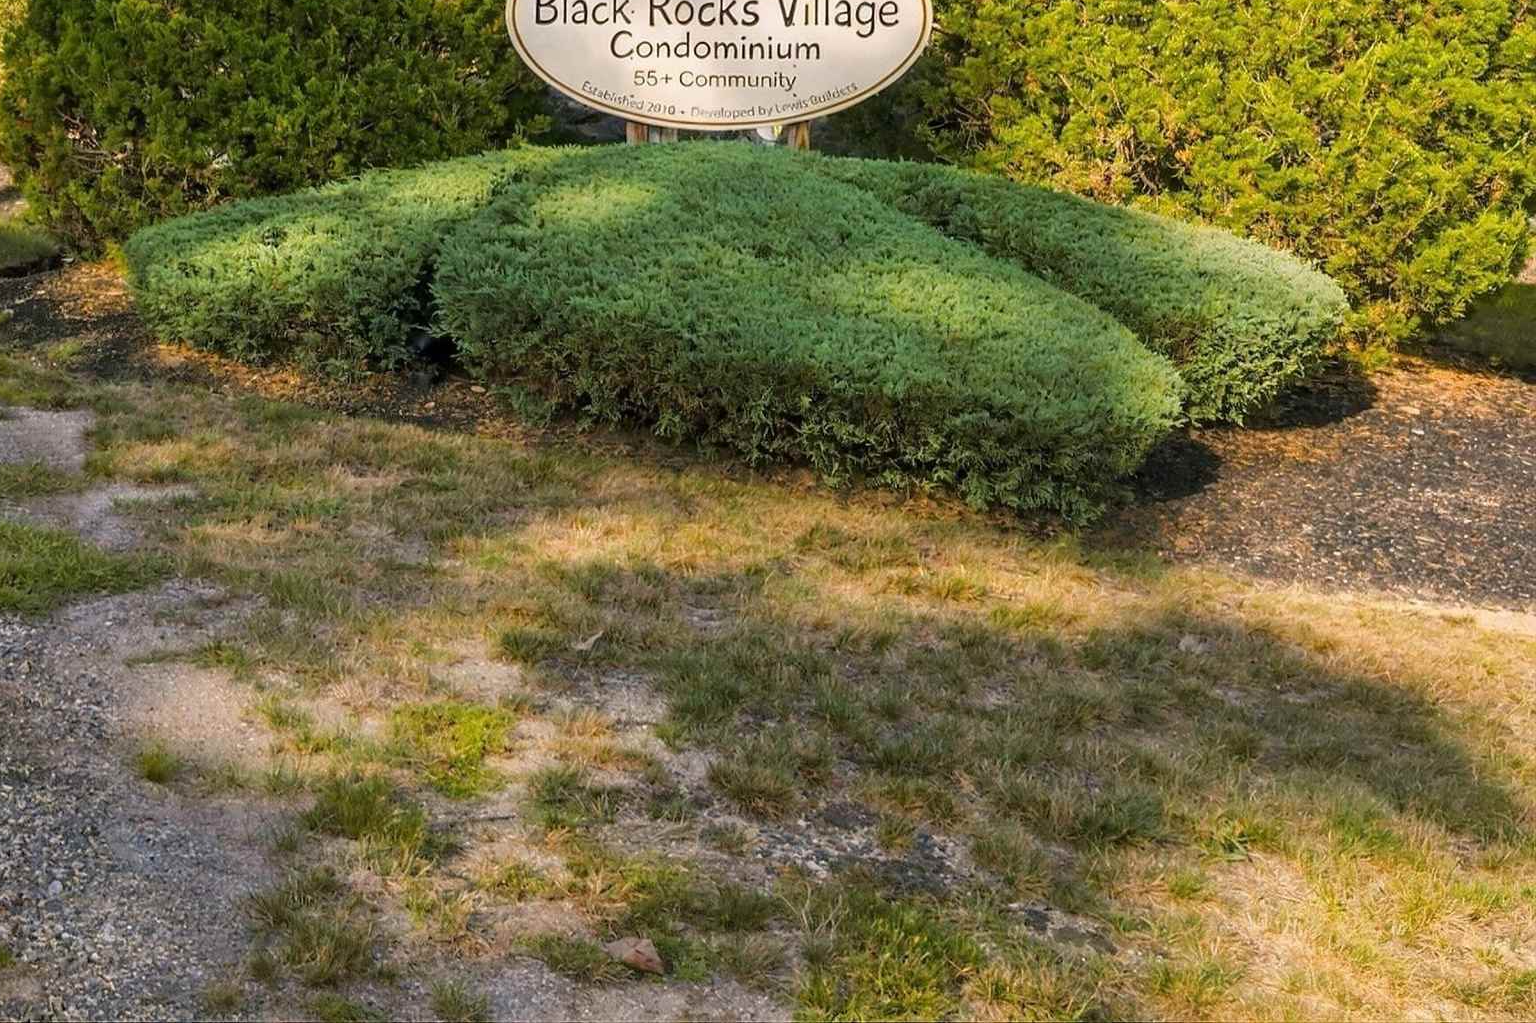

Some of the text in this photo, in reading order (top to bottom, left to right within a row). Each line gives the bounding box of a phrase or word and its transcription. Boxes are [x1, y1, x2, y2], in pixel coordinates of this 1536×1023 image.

[610, 30, 821, 60] Condominium
[633, 70, 797, 92] 55+ Community
[581, 80, 645, 110] Established
[758, 105, 773, 116] by
